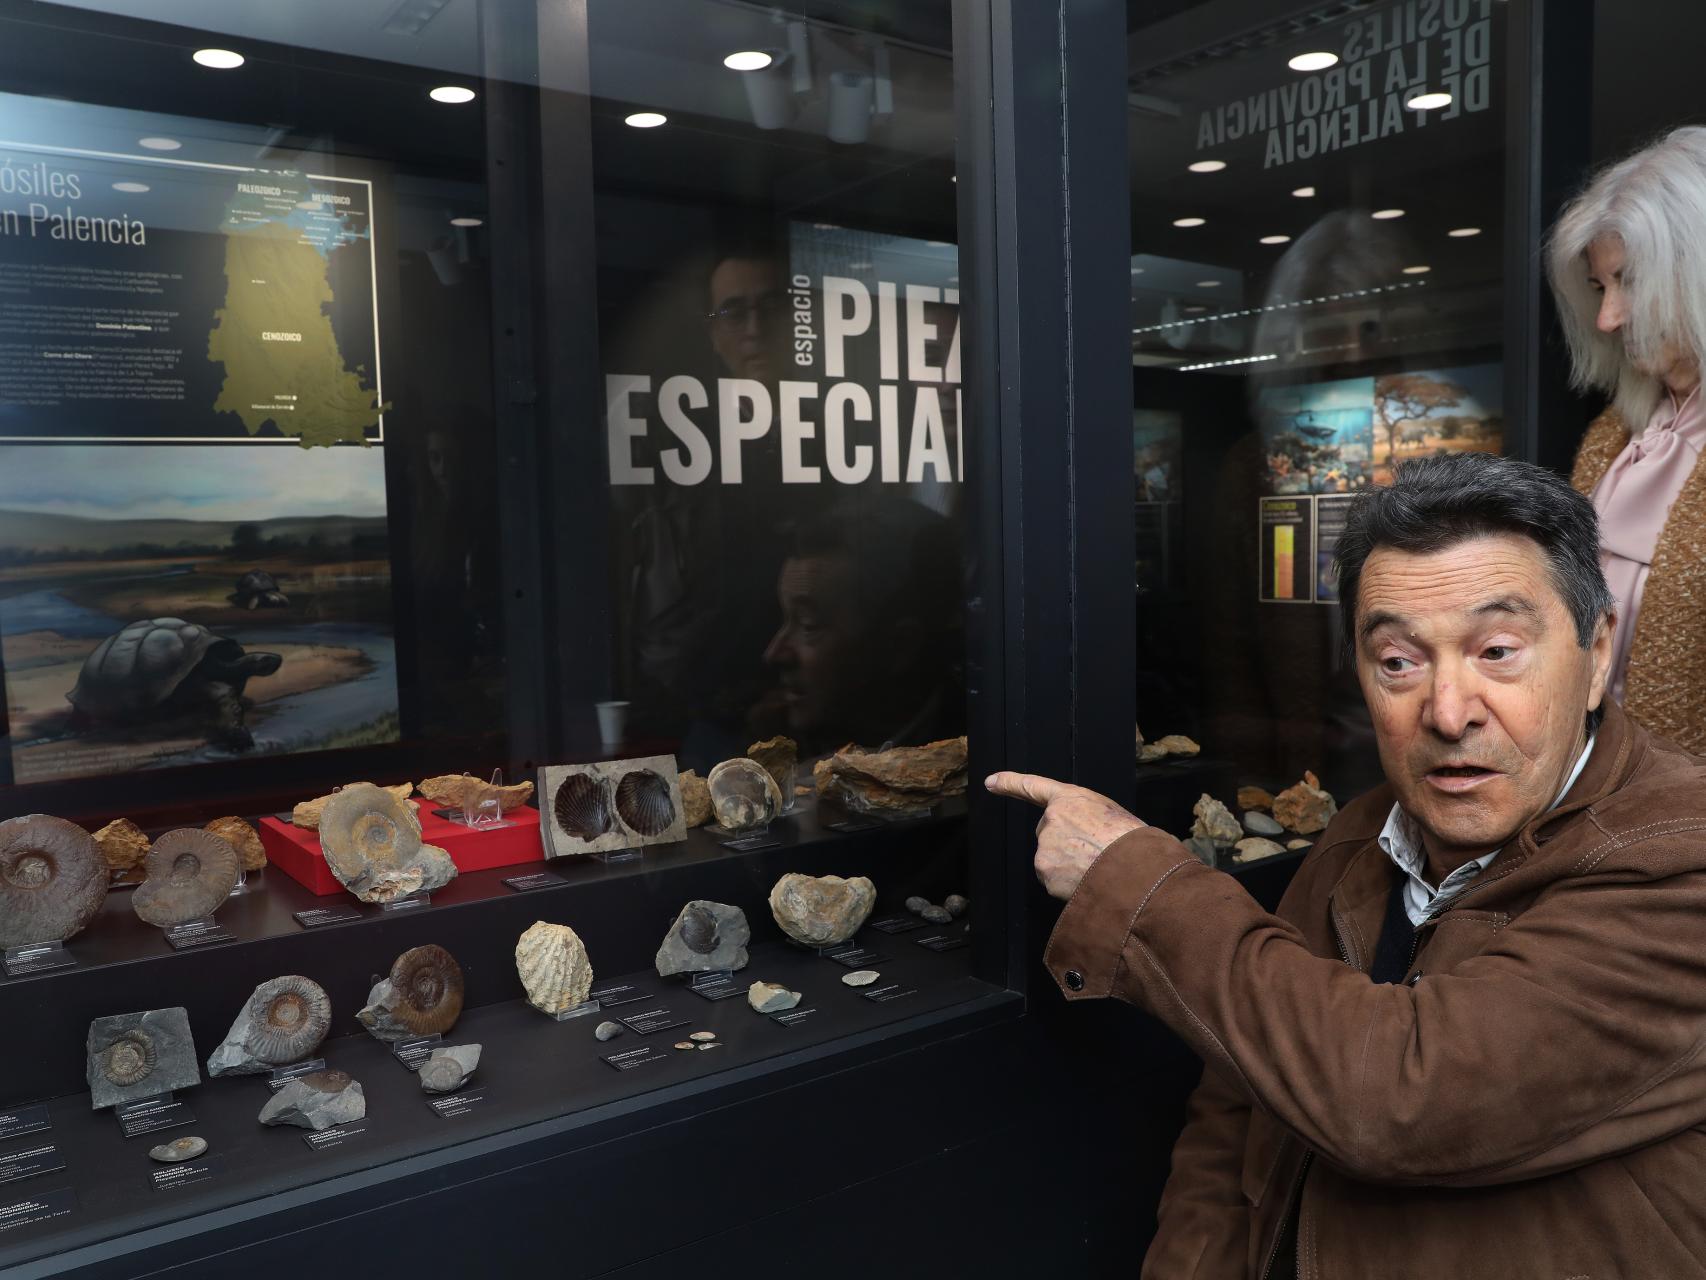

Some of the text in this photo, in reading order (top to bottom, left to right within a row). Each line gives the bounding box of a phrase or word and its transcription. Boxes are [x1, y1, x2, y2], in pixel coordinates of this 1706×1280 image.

[0, 158, 82, 200] ósiles
[0, 203, 146, 246] n Palencia
[262, 331, 302, 342] CENOZOICO
[788, 274, 818, 366] espacio
[605, 374, 964, 486] ESPECIA
[153, 1166, 185, 1176] MOLUSCO
